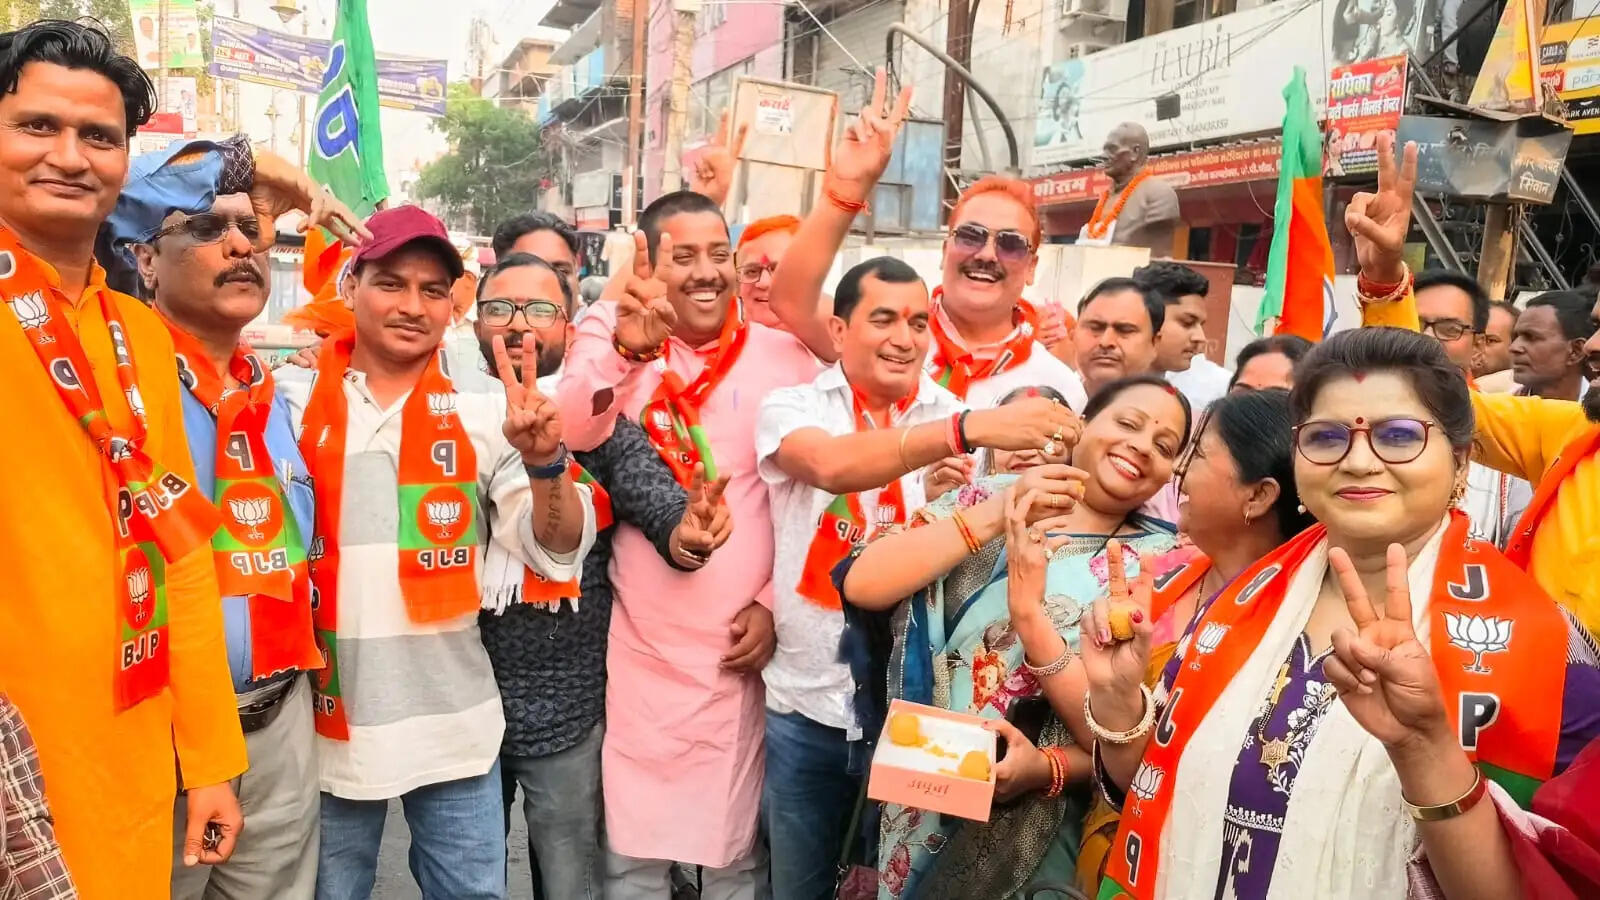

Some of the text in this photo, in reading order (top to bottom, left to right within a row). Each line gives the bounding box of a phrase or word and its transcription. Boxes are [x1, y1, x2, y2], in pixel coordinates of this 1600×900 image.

[1520, 171, 1551, 196] सिवान
[1448, 563, 1490, 602] J
[121, 629, 160, 671] BJP
[1458, 691, 1501, 751] P
